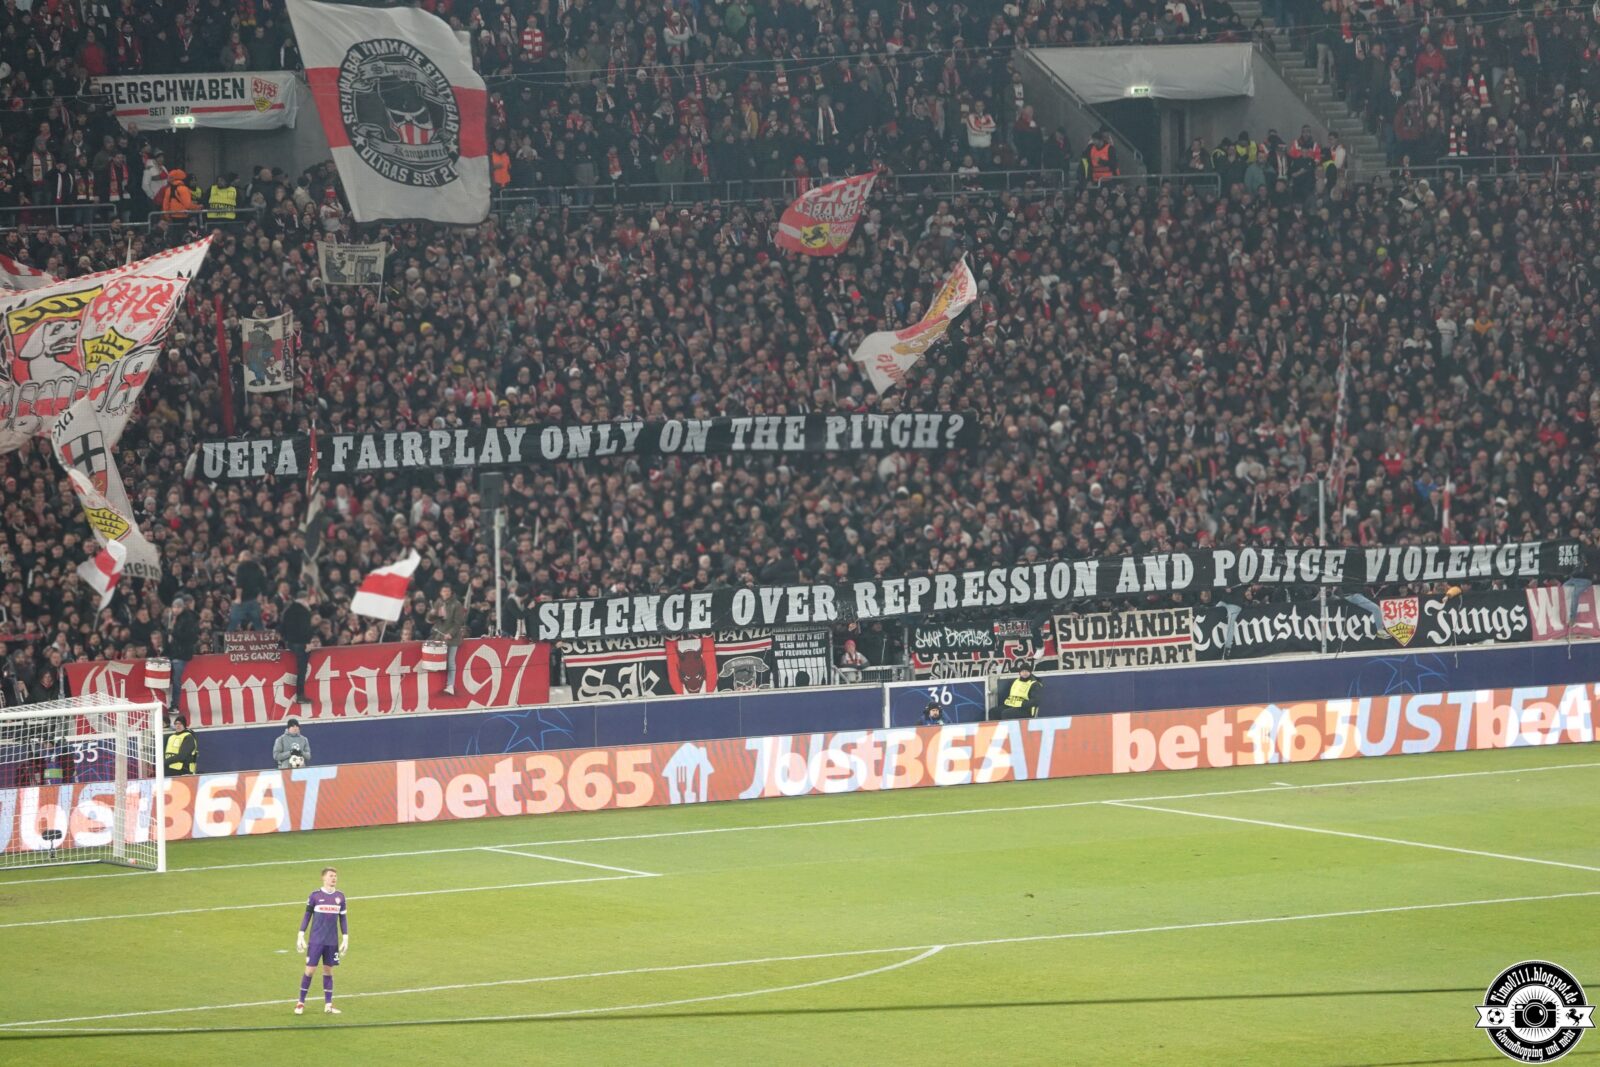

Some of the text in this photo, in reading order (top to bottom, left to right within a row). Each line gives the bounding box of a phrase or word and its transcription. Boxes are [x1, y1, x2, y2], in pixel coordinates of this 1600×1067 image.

[149, 107, 167, 117] SEIT
[360, 146, 409, 182] ULTRAS
[202, 439, 299, 479] UEFA
[331, 427, 527, 473] FAIRPLAY
[540, 421, 646, 460] ONLY
[658, 419, 714, 453] ON
[730, 415, 806, 451] THE
[824, 413, 964, 450] PITCH?
[538, 541, 1541, 641] SILENCE OVER REPRESSION AND POLICE VIOLENCE
[1424, 599, 1529, 645] Jungs
[461, 643, 536, 708] 97
[1062, 644, 1193, 670] STUTTGART
[927, 686, 953, 706] 36
[1507, 682, 1600, 747] EA
[73, 742, 99, 764] 35
[396, 749, 653, 824] bet365
